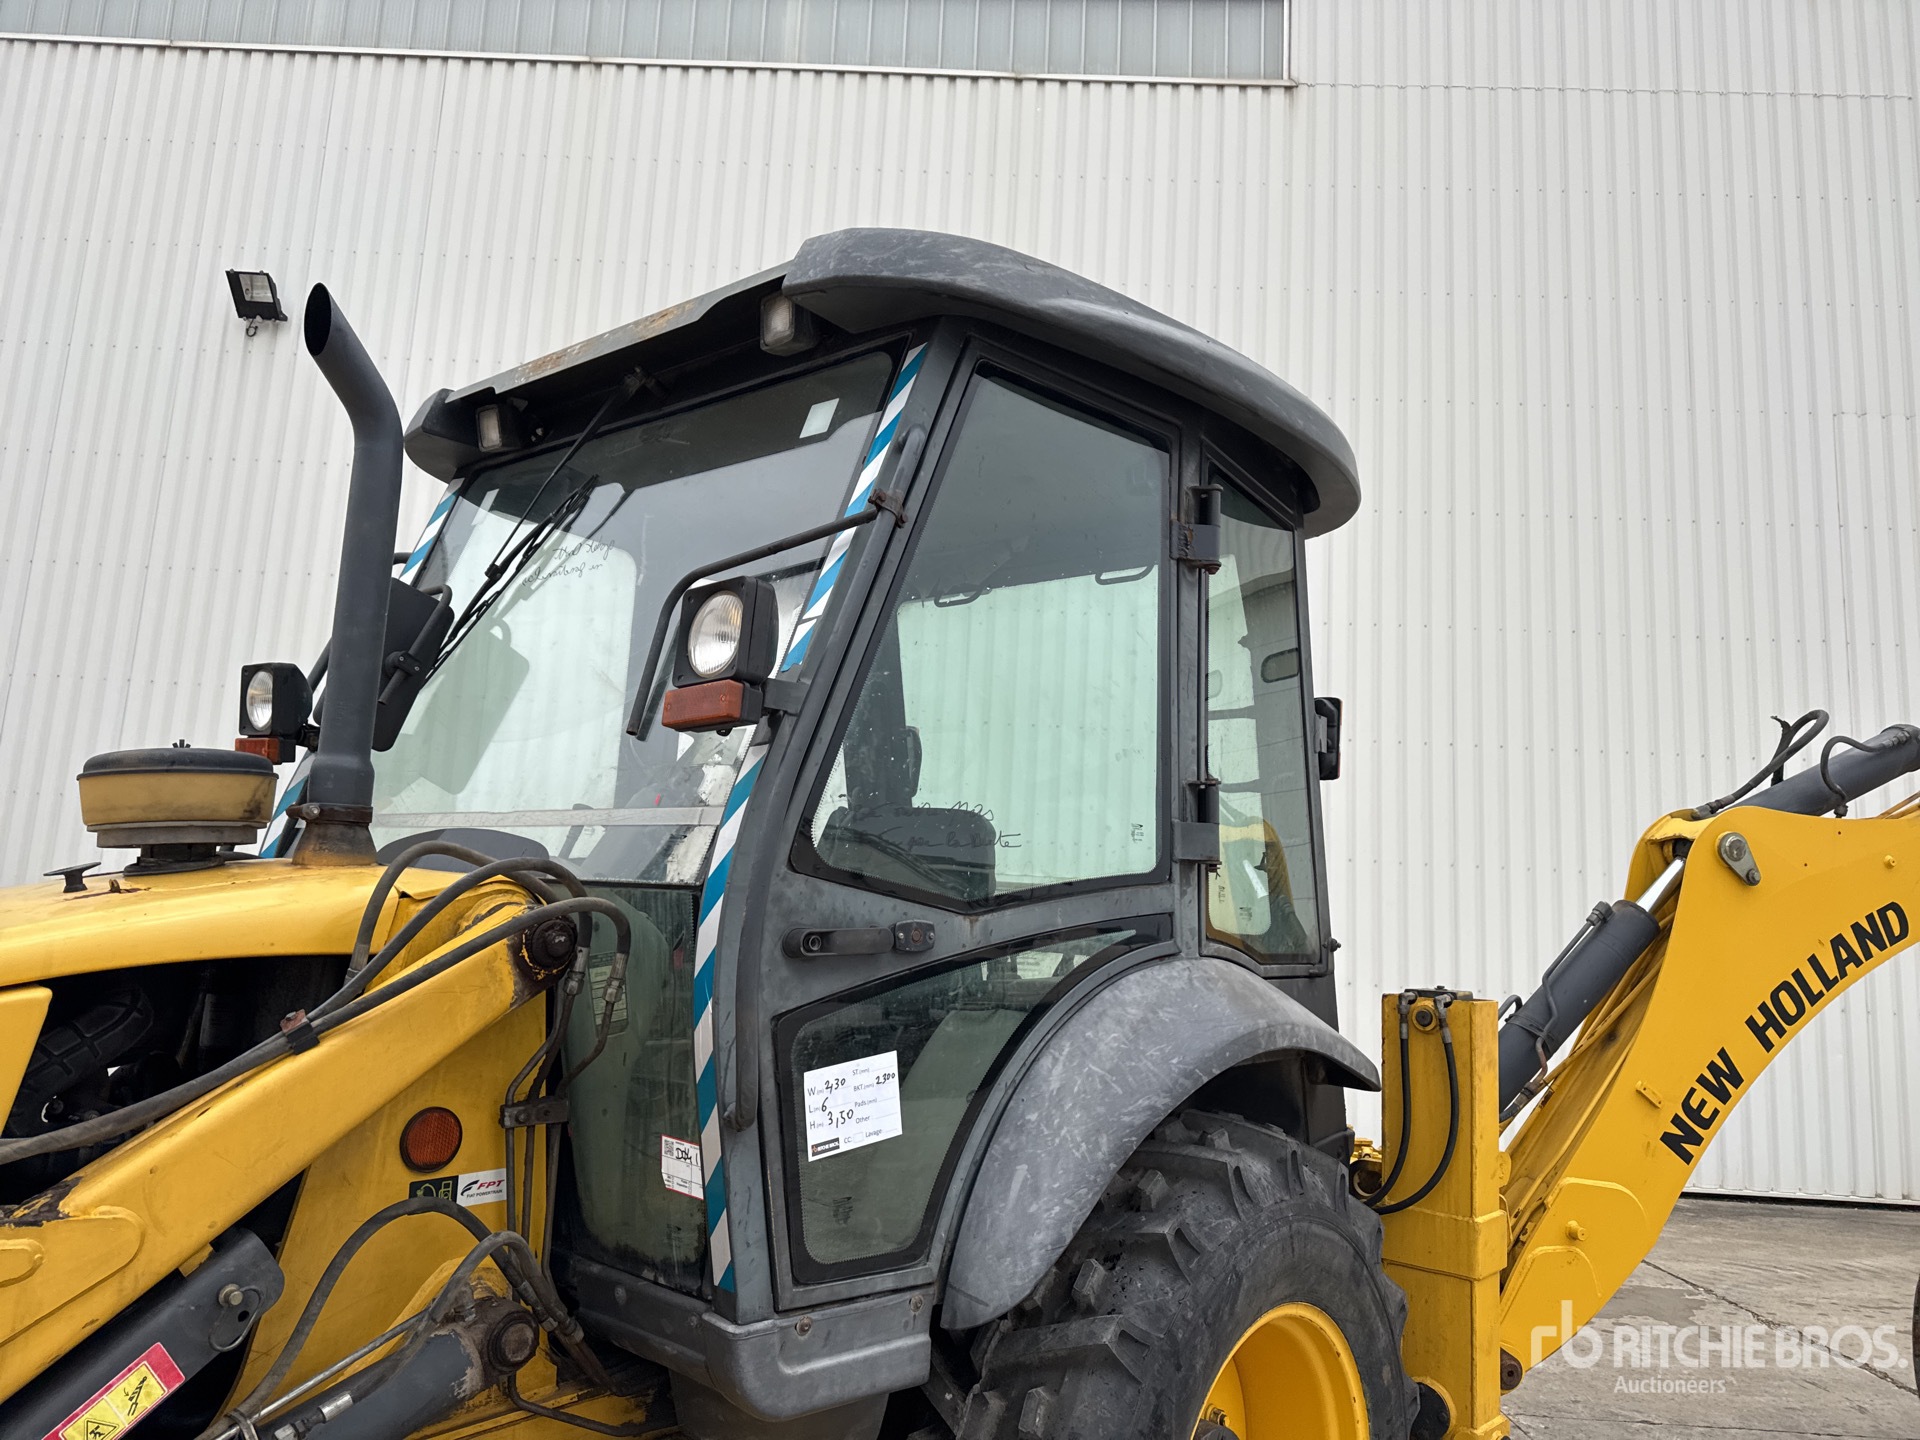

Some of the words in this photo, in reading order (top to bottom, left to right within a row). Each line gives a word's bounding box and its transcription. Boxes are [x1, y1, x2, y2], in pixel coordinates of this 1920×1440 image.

[1660, 1047, 1744, 1165] NEW
[1745, 901, 1909, 1053] HOLLAND
[821, 1097, 829, 1112] 6
[477, 1179, 506, 1190] FPT
